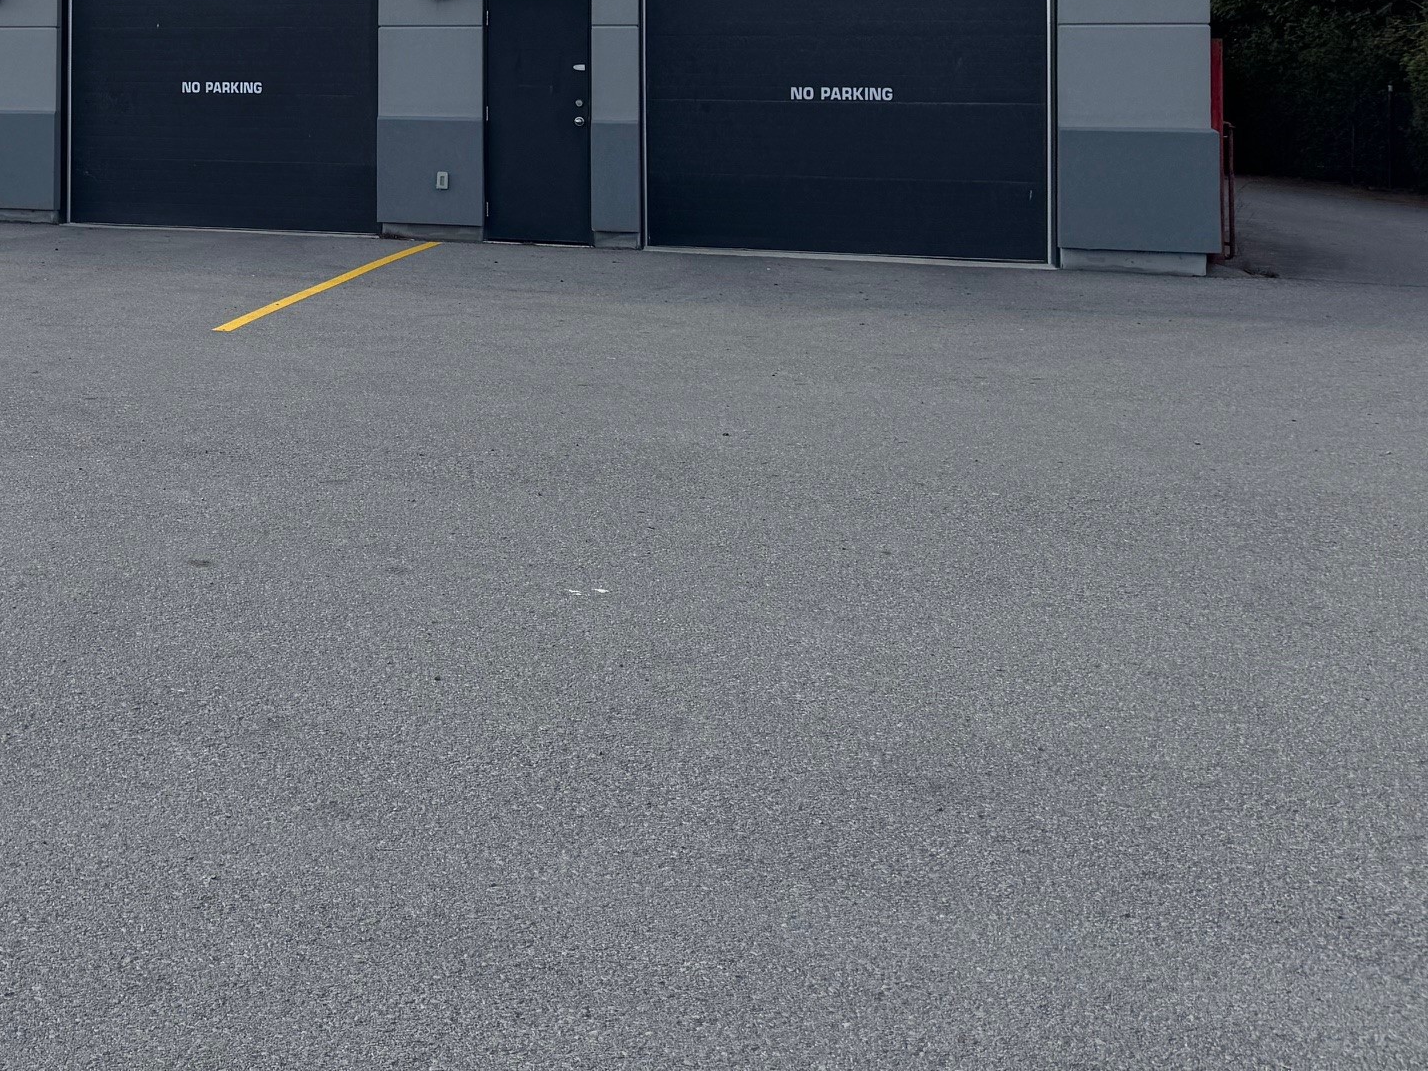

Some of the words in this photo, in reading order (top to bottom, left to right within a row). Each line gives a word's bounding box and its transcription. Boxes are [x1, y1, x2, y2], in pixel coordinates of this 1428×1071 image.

[181, 82, 200, 93] NO
[205, 82, 262, 94] PARKING
[790, 87, 814, 100] NO
[820, 87, 893, 100] PARKING
